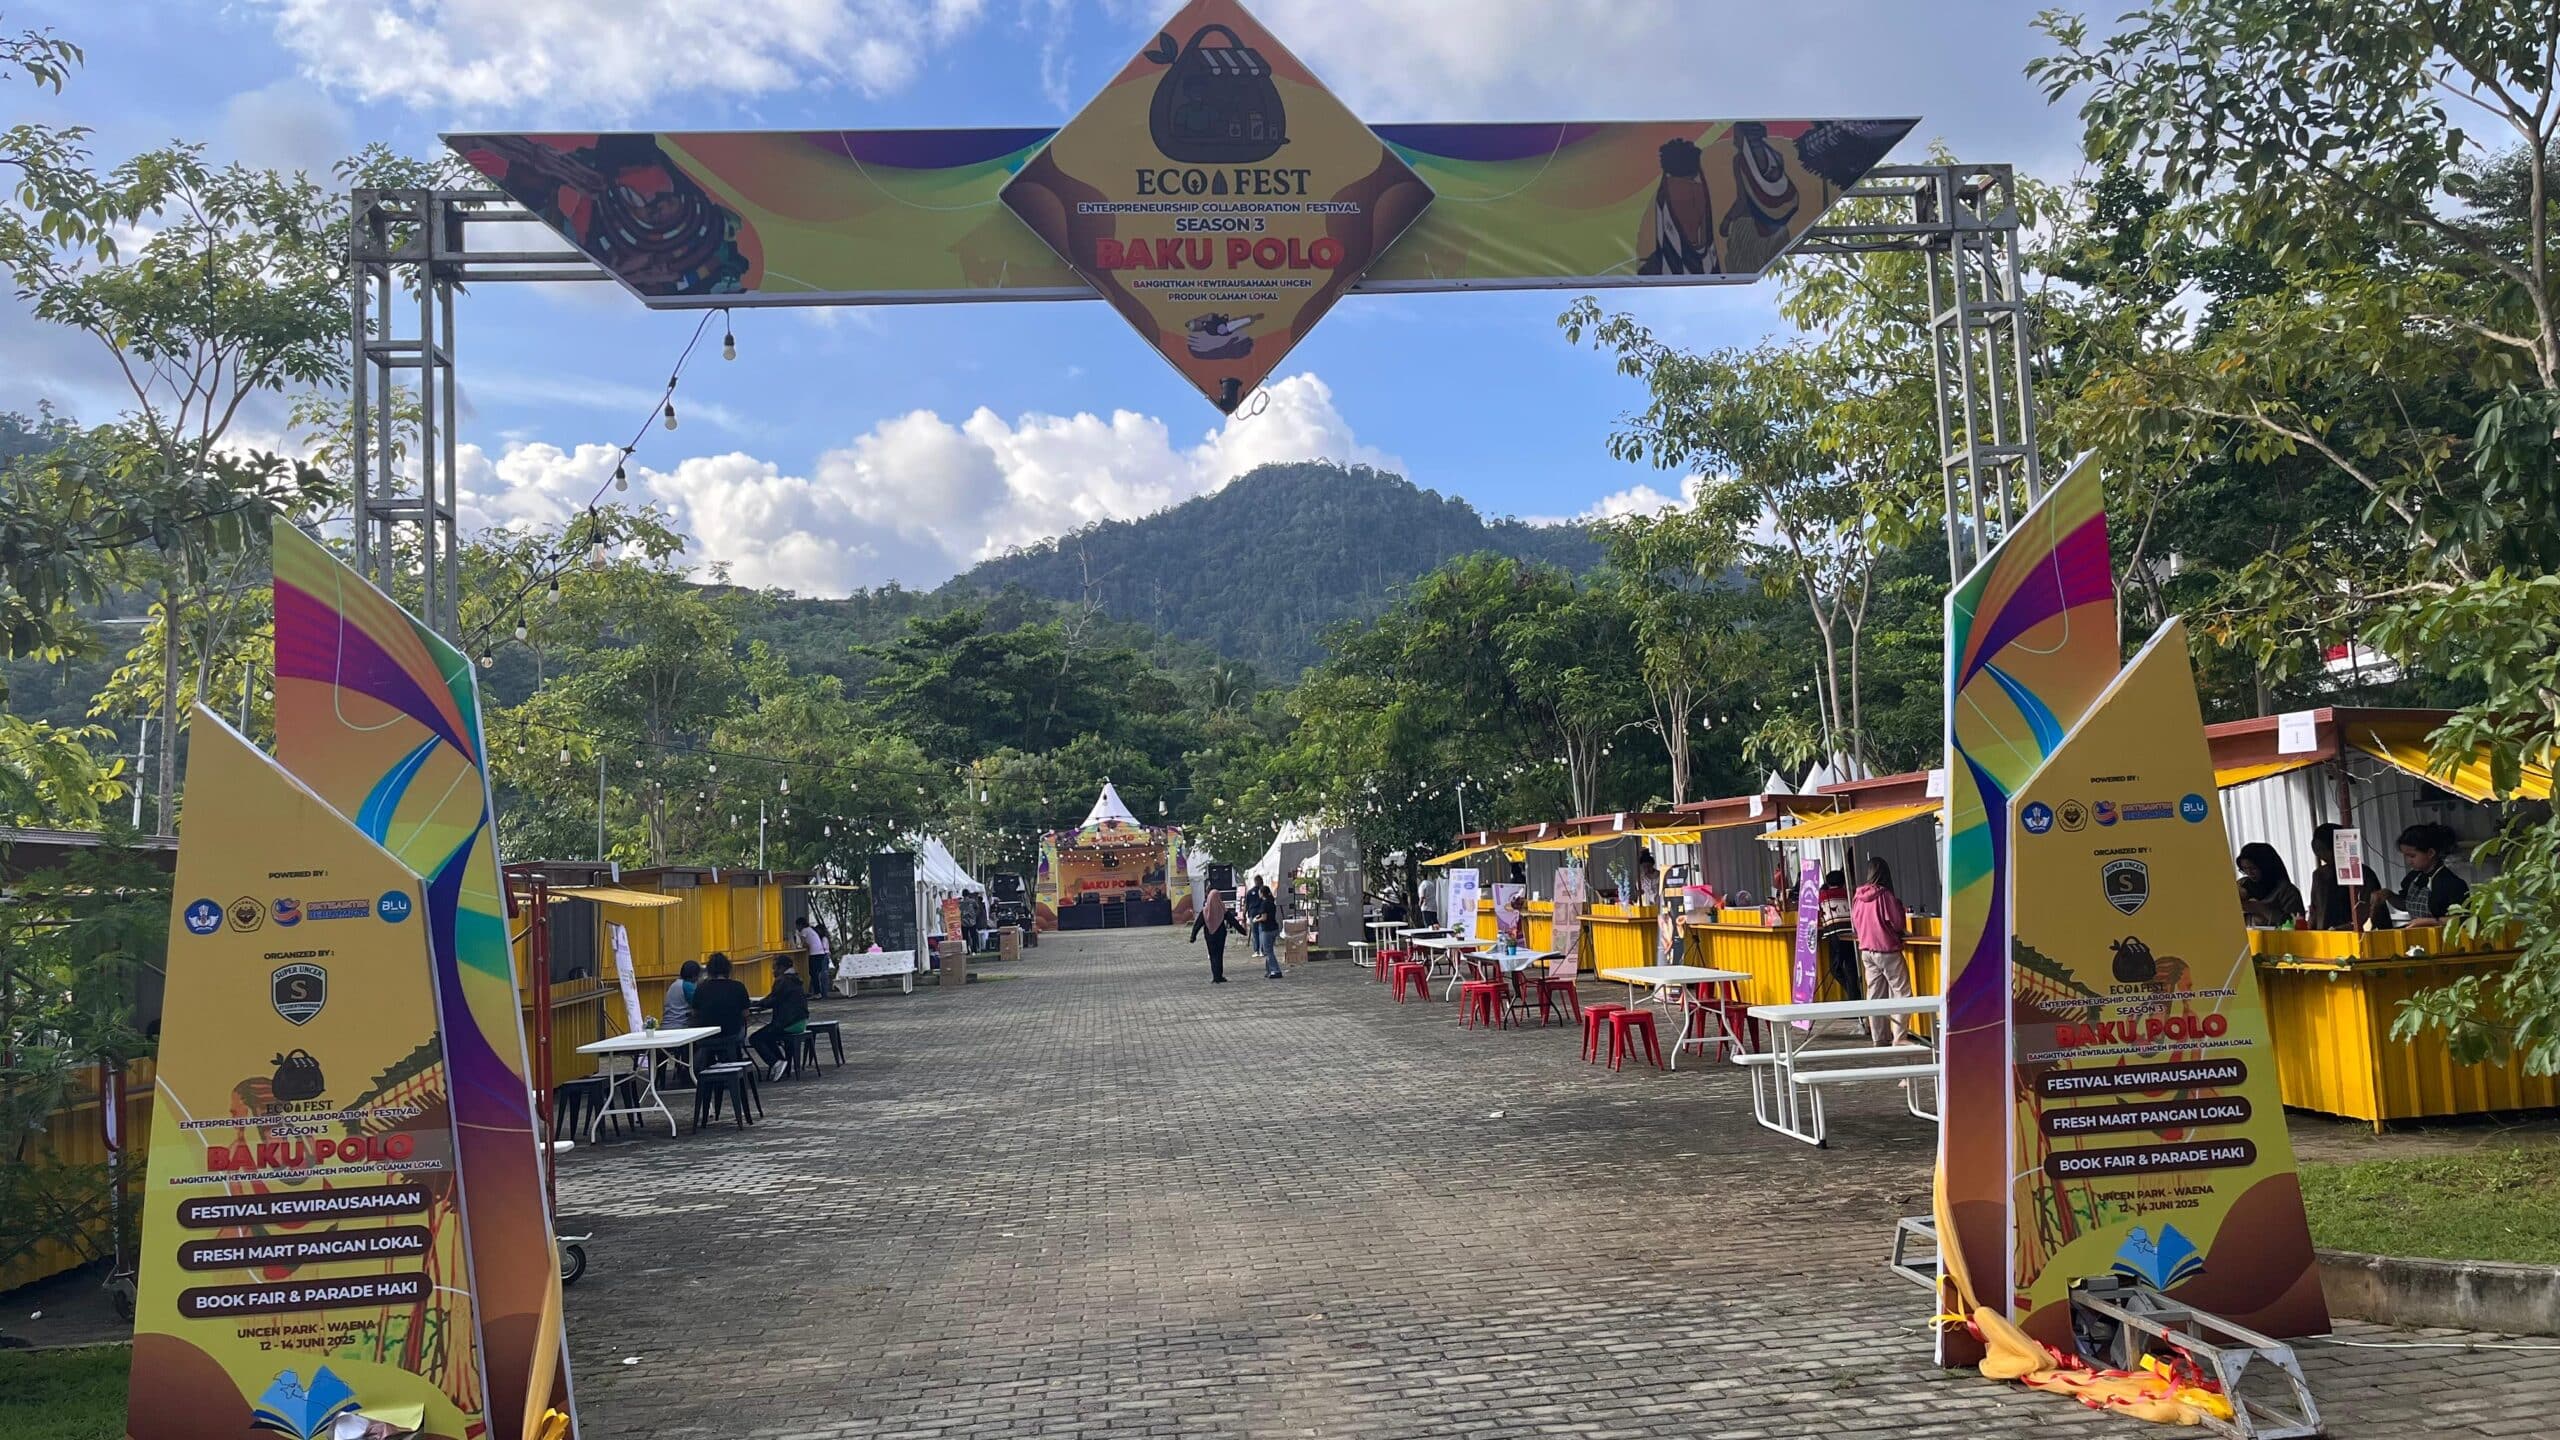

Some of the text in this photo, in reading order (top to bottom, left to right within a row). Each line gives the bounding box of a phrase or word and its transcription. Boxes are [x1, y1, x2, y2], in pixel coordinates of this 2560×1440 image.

[1136, 169, 1311, 195] ECO FEST
[1078, 202, 1360, 214] ENTERPRENEURSHIP COLLABORATION FESTIVAL
[1176, 218, 1265, 232] SEASON 3
[1096, 237, 1345, 270] BAKU POLO
[1133, 279, 1312, 289] BANGKITKAN KEWIRAUSAHAAN UNCEN
[1168, 292, 1279, 302] PRODUK OLAHAN LOKAL
[2183, 803, 2204, 812] BLU
[268, 871, 311, 879] POWERED
[2119, 874, 2133, 892] S
[382, 901, 407, 911] BLU
[264, 951, 316, 960] ORGANIZED
[318, 949, 330, 957] BY
[275, 966, 298, 980] SUPER
[290, 980, 307, 1000] S
[2110, 984, 2134, 995] ECO
[2039, 988, 2237, 1009] ENTERPRENEURSHIP COLLABORATION FESTIVAL
[2116, 1006, 2156, 1016] SEASON
[2055, 1013, 2228, 1048] BAKU POLO
[2168, 1042, 2198, 1051] PRODUK
[2047, 1066, 2238, 1091] FESTIVAL KEWIRAUSAHAAN
[267, 1100, 333, 1115] ECO FEST
[180, 1108, 420, 1129] ENTERPRENEURSHIP COLLABORATION FESTIVAL
[2053, 1105, 2244, 1130] FRESH MART PANGAN LOKAL
[271, 1125, 328, 1137] SEASON 3
[207, 1133, 416, 1172] BAKU POLO
[2060, 1147, 2244, 1171] BOOK FAIR & PARADE HAKI
[338, 1165, 375, 1174] PRODUK
[376, 1162, 413, 1172] OLAHAN
[414, 1160, 441, 1169] LOKAL
[2098, 1190, 2135, 1201] UNCEN
[2137, 1189, 2166, 1199] PARK
[2174, 1186, 2214, 1196] WAENA
[191, 1192, 421, 1220] FESTIVAL KEWIRAUSAHAAN
[2119, 1203, 2129, 1213] 12
[2149, 1201, 2175, 1211] JUNI
[2176, 1199, 2199, 1209] 2025
[193, 1235, 423, 1263] FRESH MART PANGAN LOKAL
[196, 1281, 418, 1309] BOOK FAIR & PARADE HAKI
[237, 1327, 280, 1339] UNCEN
[284, 1323, 317, 1336] PARK
[327, 1319, 376, 1332] WAENA
[260, 1340, 271, 1351] 12
[281, 1340, 293, 1350] 14
[296, 1337, 325, 1349] JUNI
[327, 1335, 356, 1347] 2025
